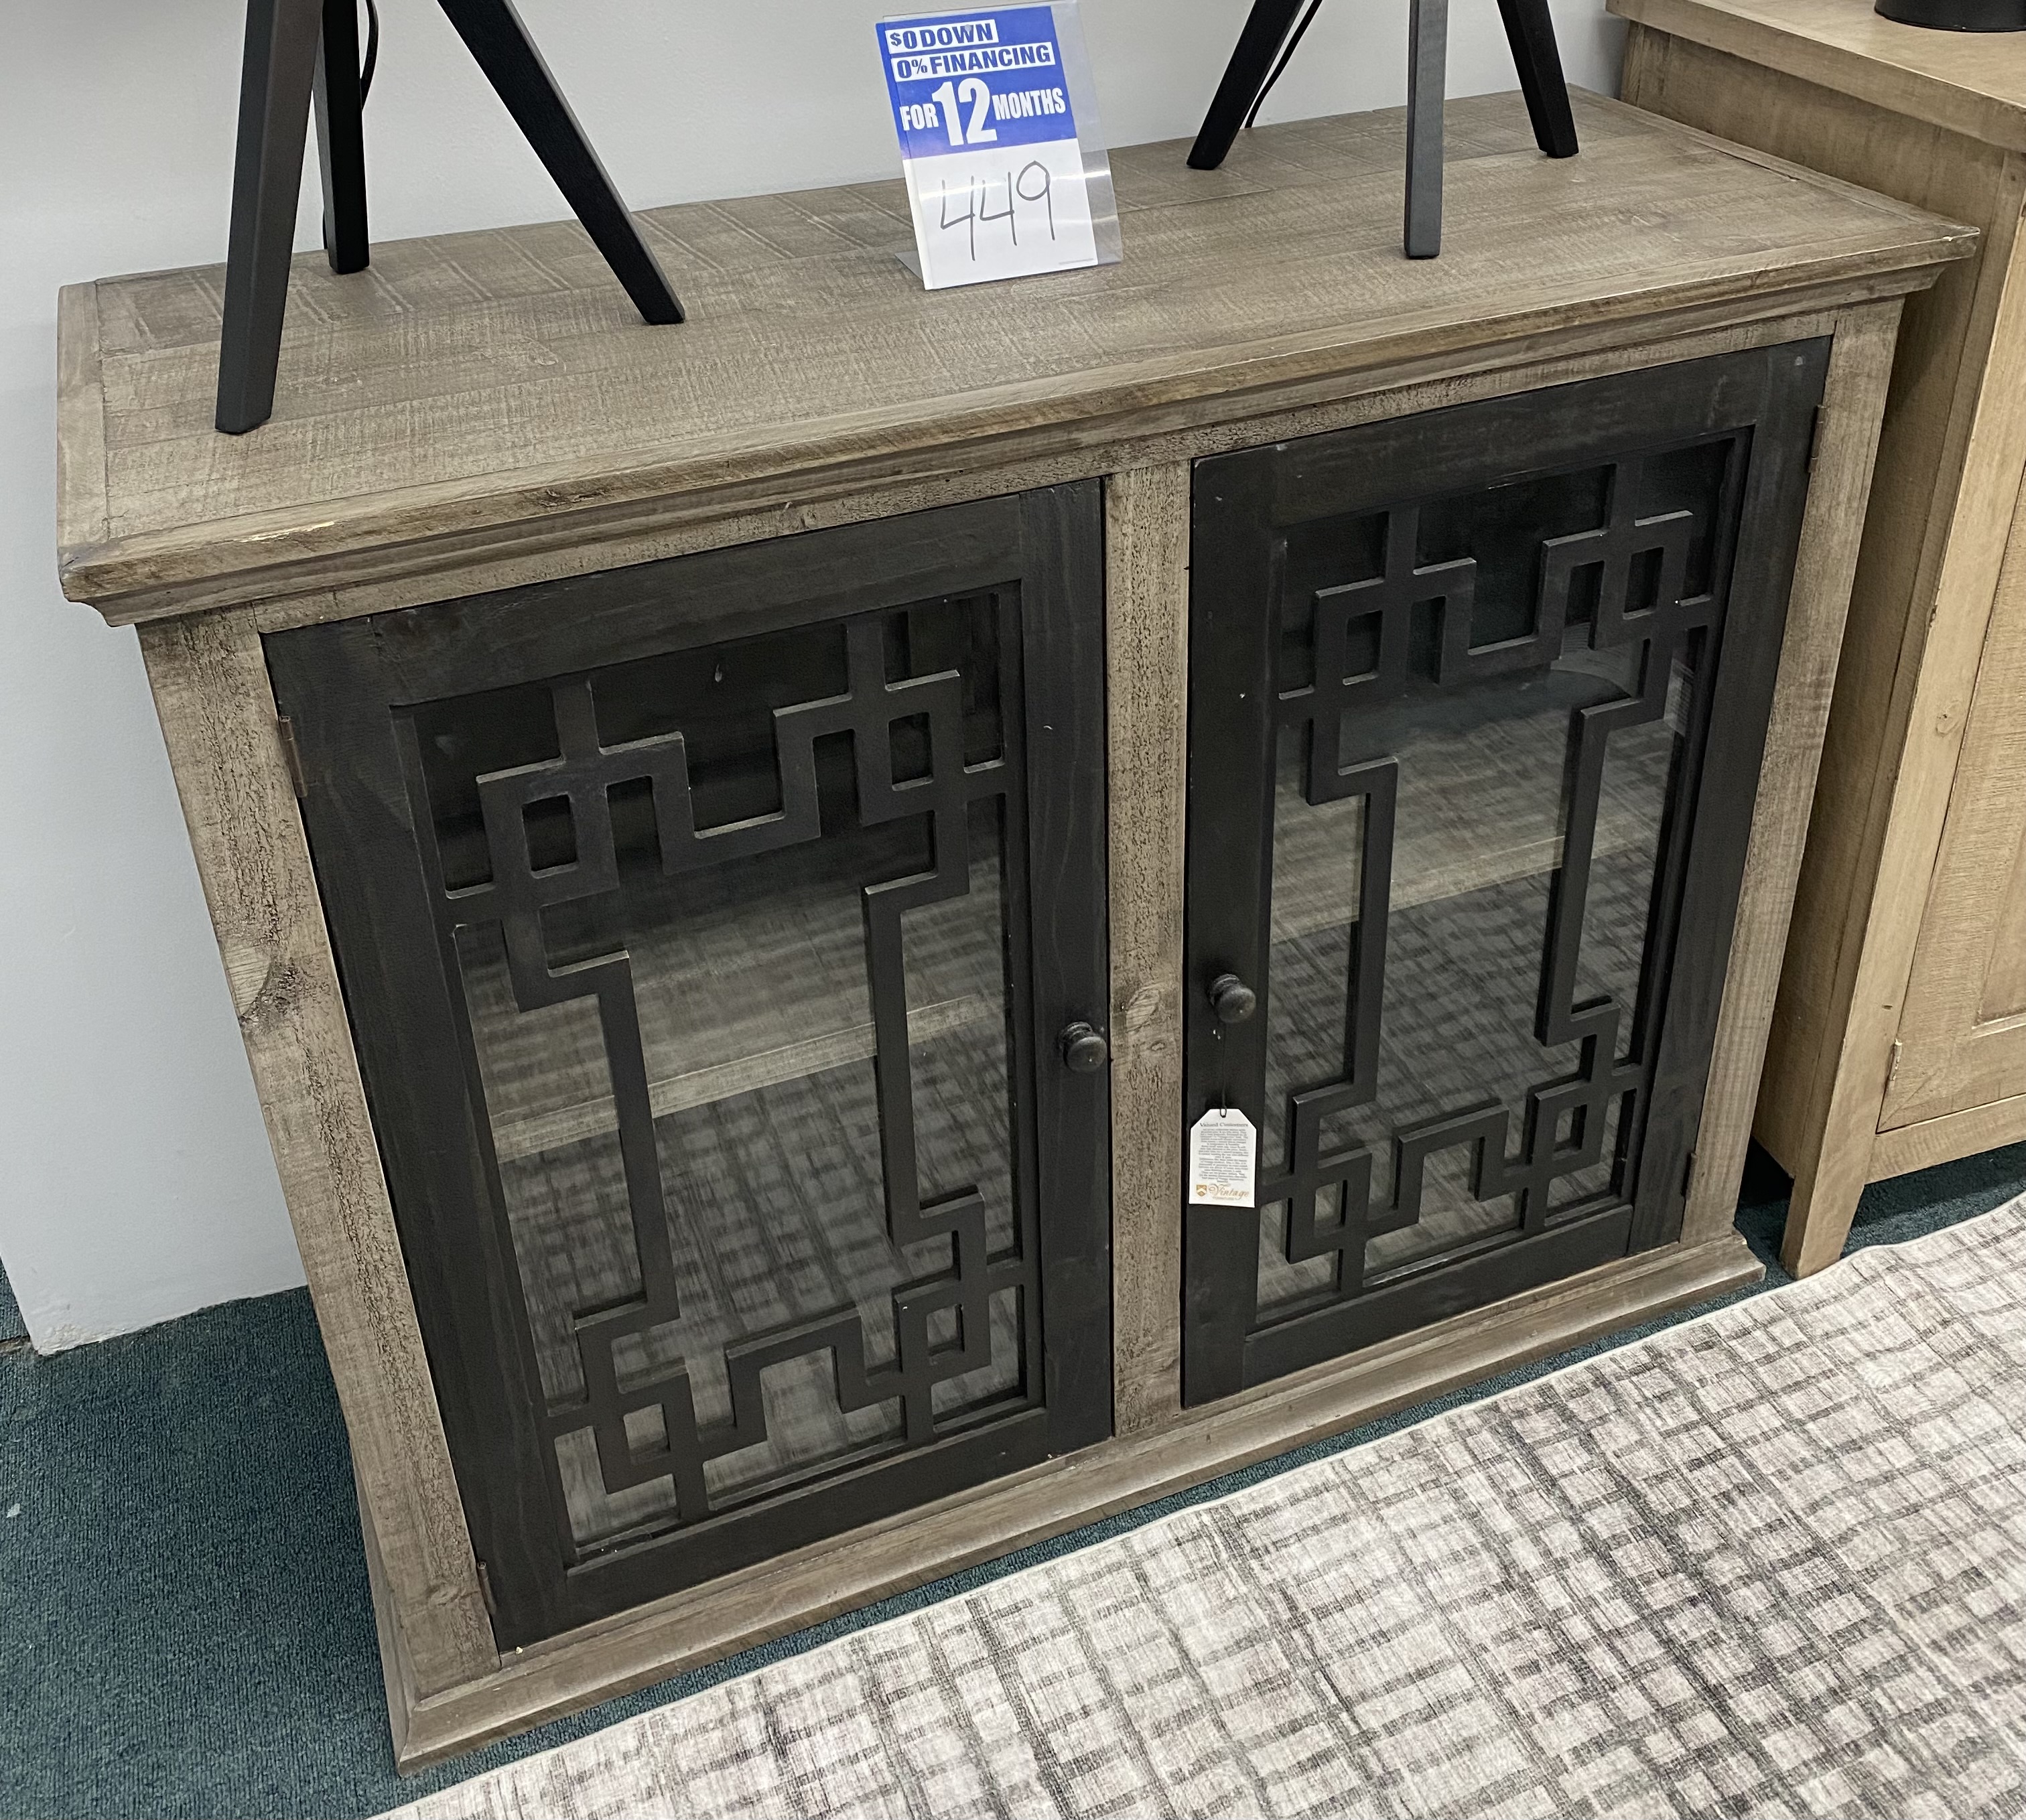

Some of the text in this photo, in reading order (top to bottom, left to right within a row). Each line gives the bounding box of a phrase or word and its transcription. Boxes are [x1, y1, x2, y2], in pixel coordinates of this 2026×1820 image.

[921, 23, 994, 48] DOWN
[896, 45, 1051, 78] 0% FINANCING
[900, 78, 1066, 146] FOR 12 MONTHS
[941, 160, 1055, 261] 449
